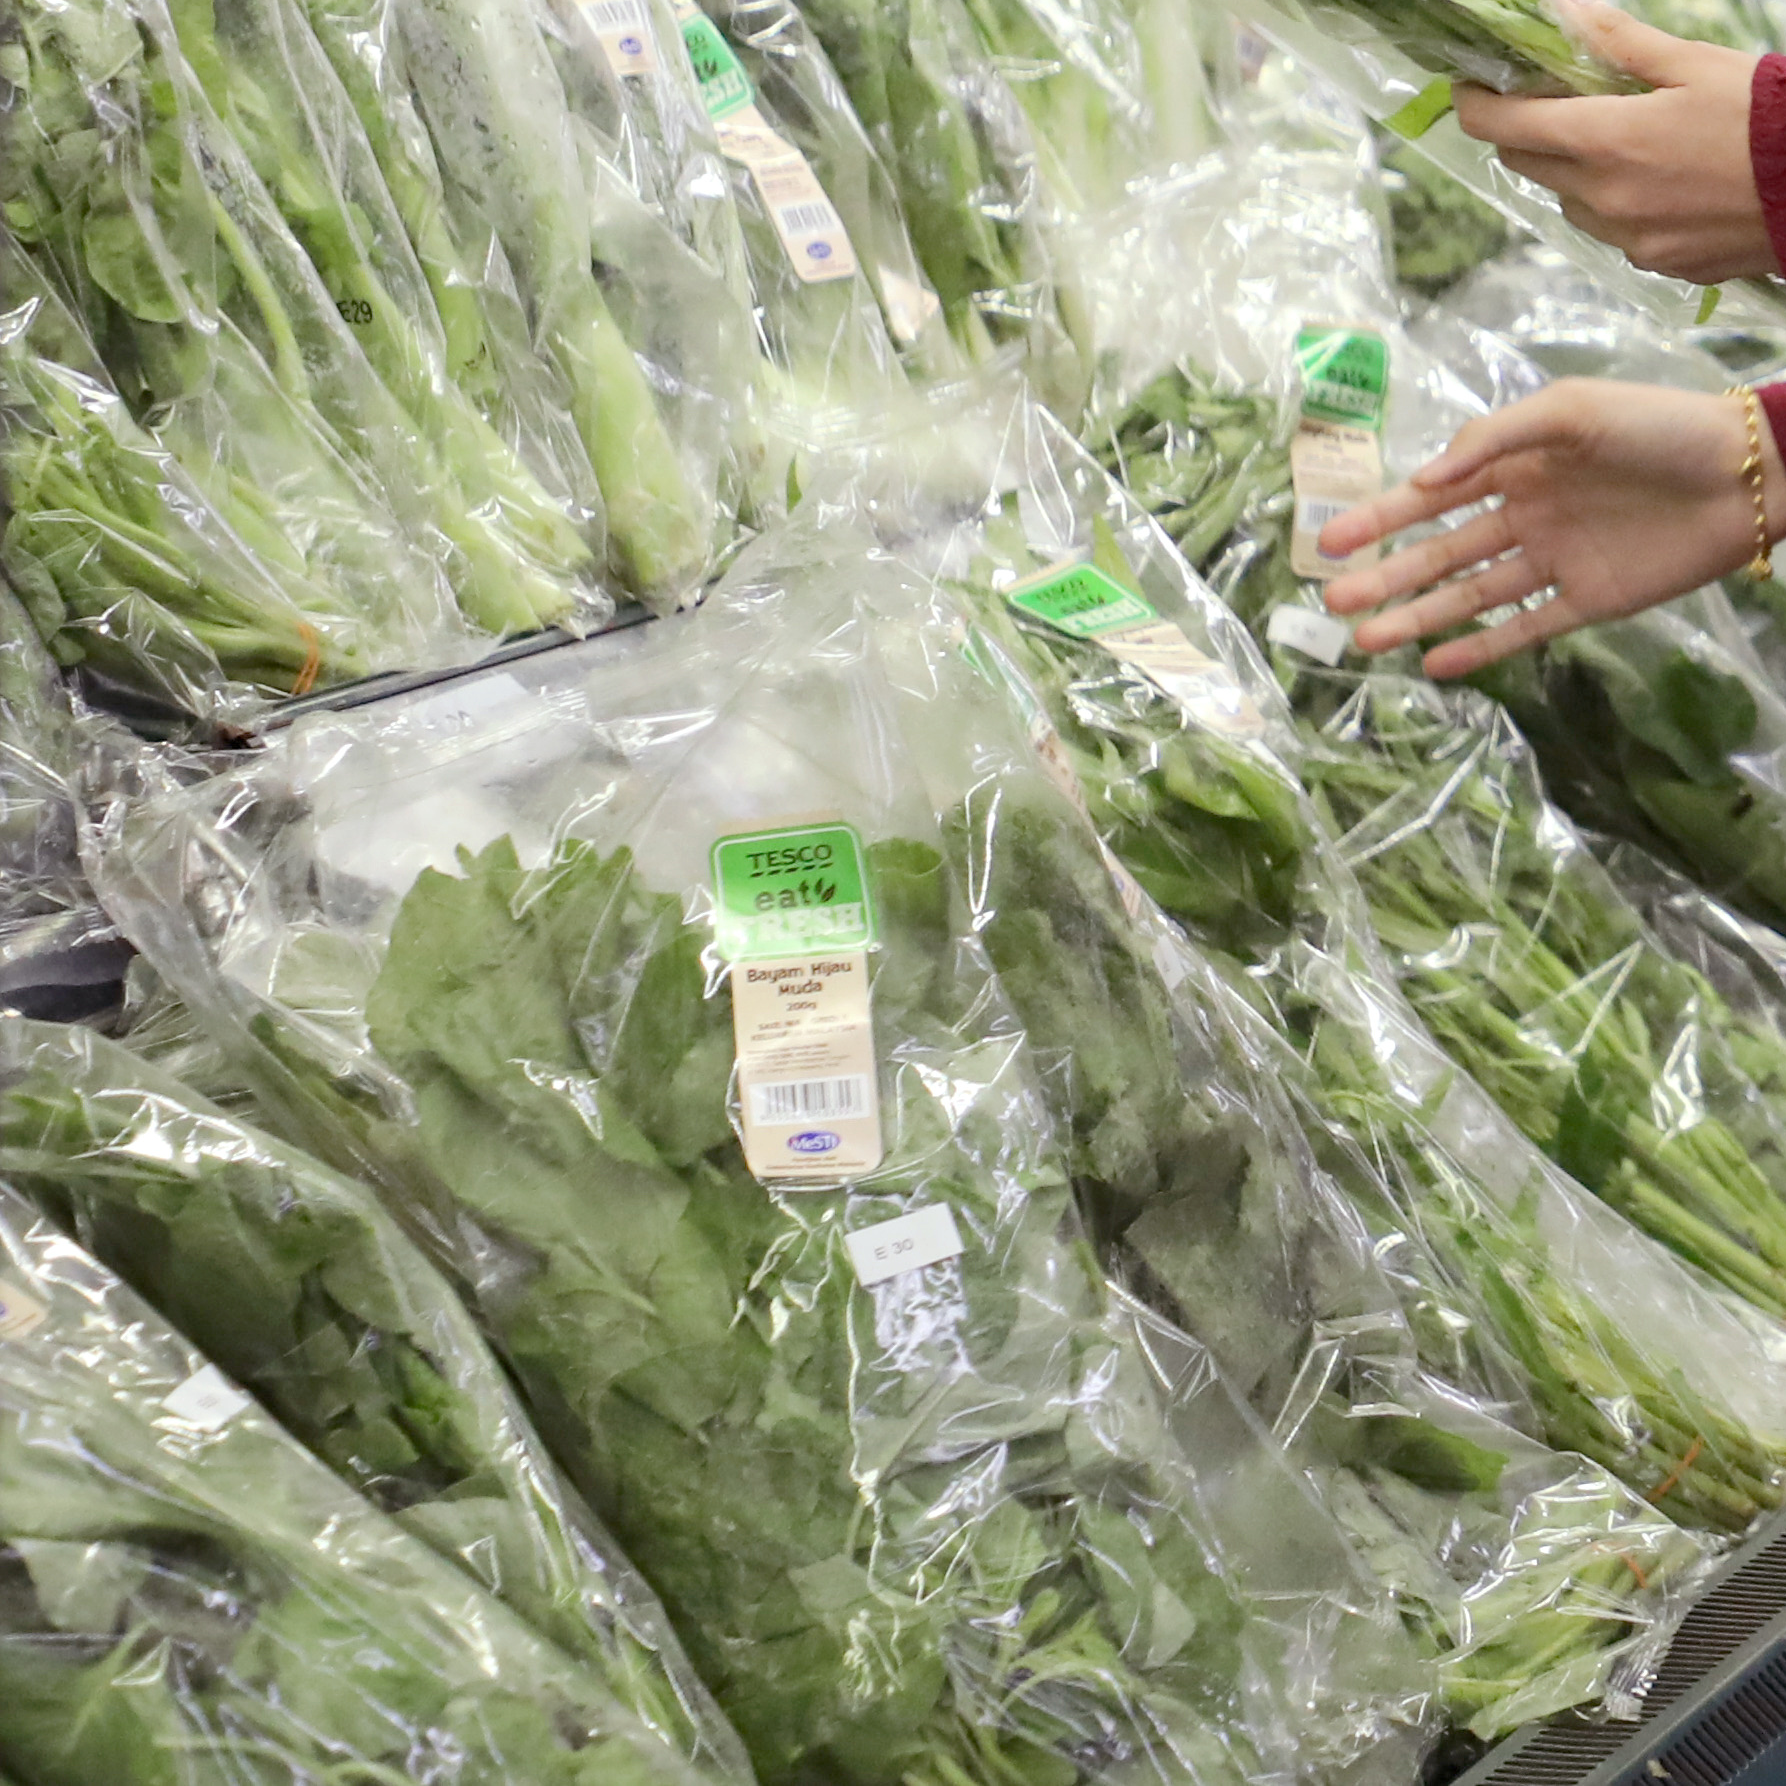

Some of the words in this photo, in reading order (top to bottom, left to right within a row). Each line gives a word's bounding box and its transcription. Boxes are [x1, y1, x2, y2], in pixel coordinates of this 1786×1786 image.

[745, 844, 833, 870] TESCO
[755, 880, 811, 912] eat
[746, 966, 805, 983] Bayam
[810, 961, 853, 977] Hijau
[778, 979, 823, 997] Muda
[785, 1000, 818, 1013] 200g
[790, 1134, 838, 1151] MeSTI
[873, 1246, 889, 1261] E
[891, 1237, 915, 1256] 30
